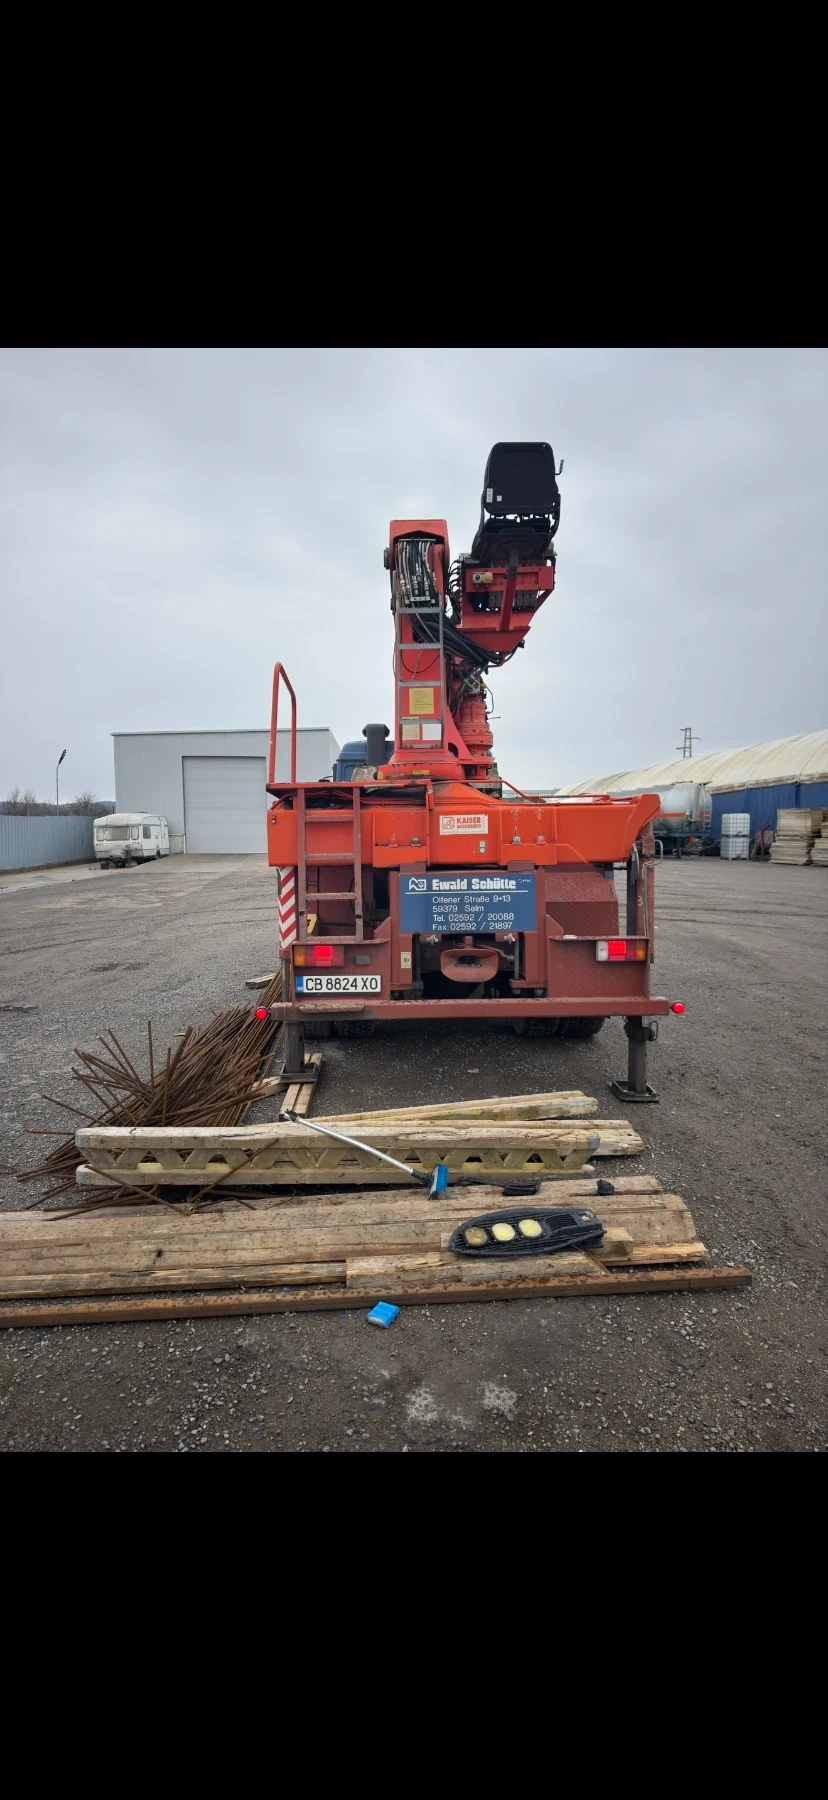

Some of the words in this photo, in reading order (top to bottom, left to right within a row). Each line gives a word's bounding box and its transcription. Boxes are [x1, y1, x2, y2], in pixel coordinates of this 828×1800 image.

[432, 878, 468, 890] Ewald
[472, 878, 516, 890] Schütte
[432, 904, 458, 913] 59379
[464, 904, 485, 912] Selm
[432, 913, 446, 922] Tel.
[448, 913, 475, 921] 02592
[488, 912, 514, 920] 20088
[450, 922, 476, 930] 02592
[489, 922, 512, 930] 21897
[305, 977, 323, 991] CB
[325, 977, 358, 991] 8824
